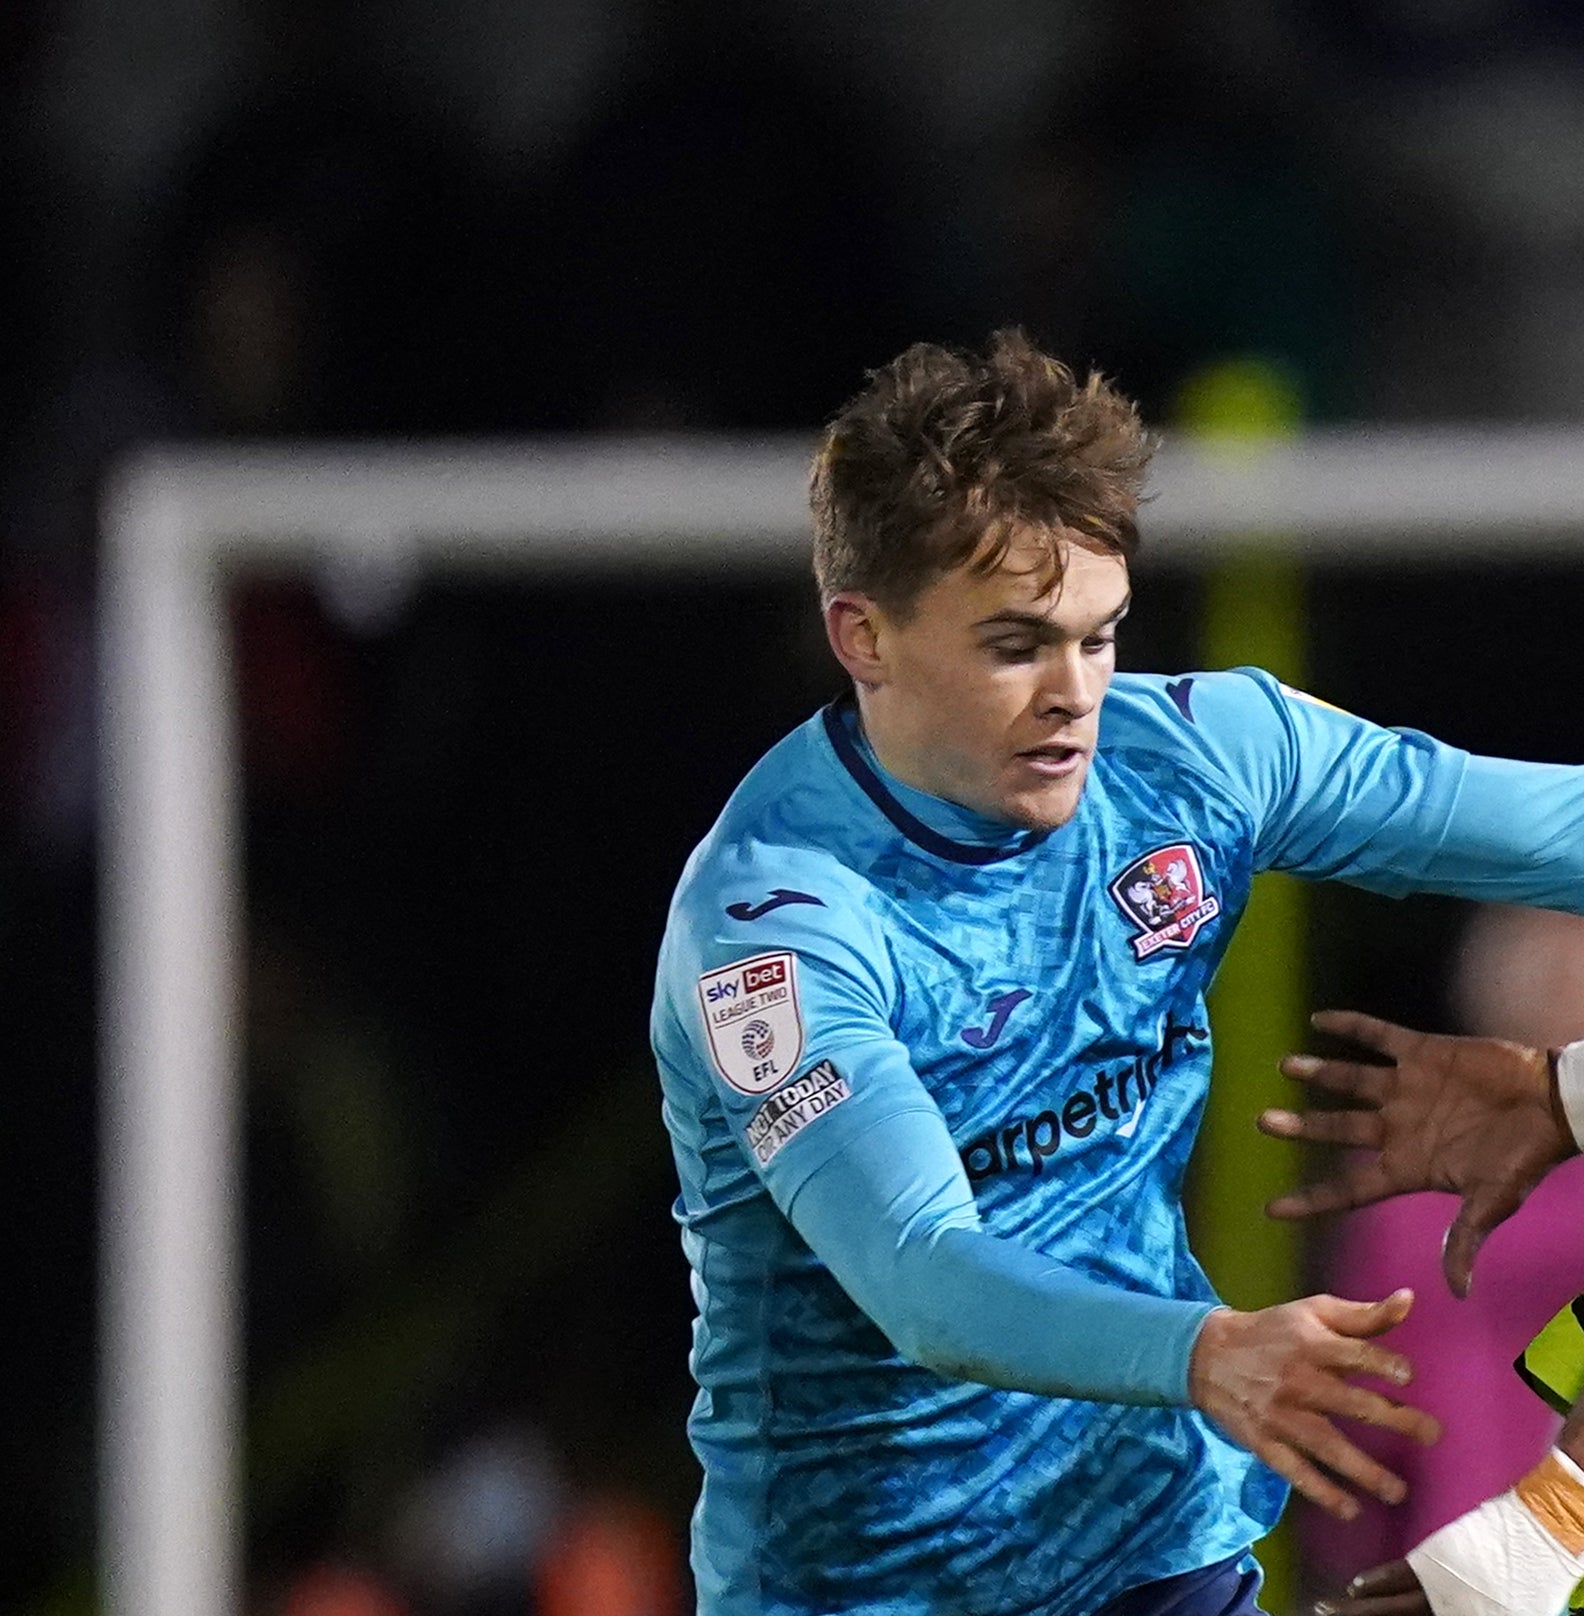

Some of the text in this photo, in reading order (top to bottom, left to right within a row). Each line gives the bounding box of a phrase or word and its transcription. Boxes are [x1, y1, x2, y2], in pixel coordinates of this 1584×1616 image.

[1140, 901, 1215, 951] EXETER CITY FC
[706, 964, 784, 1003] sky bet
[712, 986, 788, 1024] LEAGUE TWO
[752, 1061, 779, 1082] EFL
[747, 1061, 836, 1147] NOT TODAY
[757, 1081, 846, 1163] OR ANY DAY
